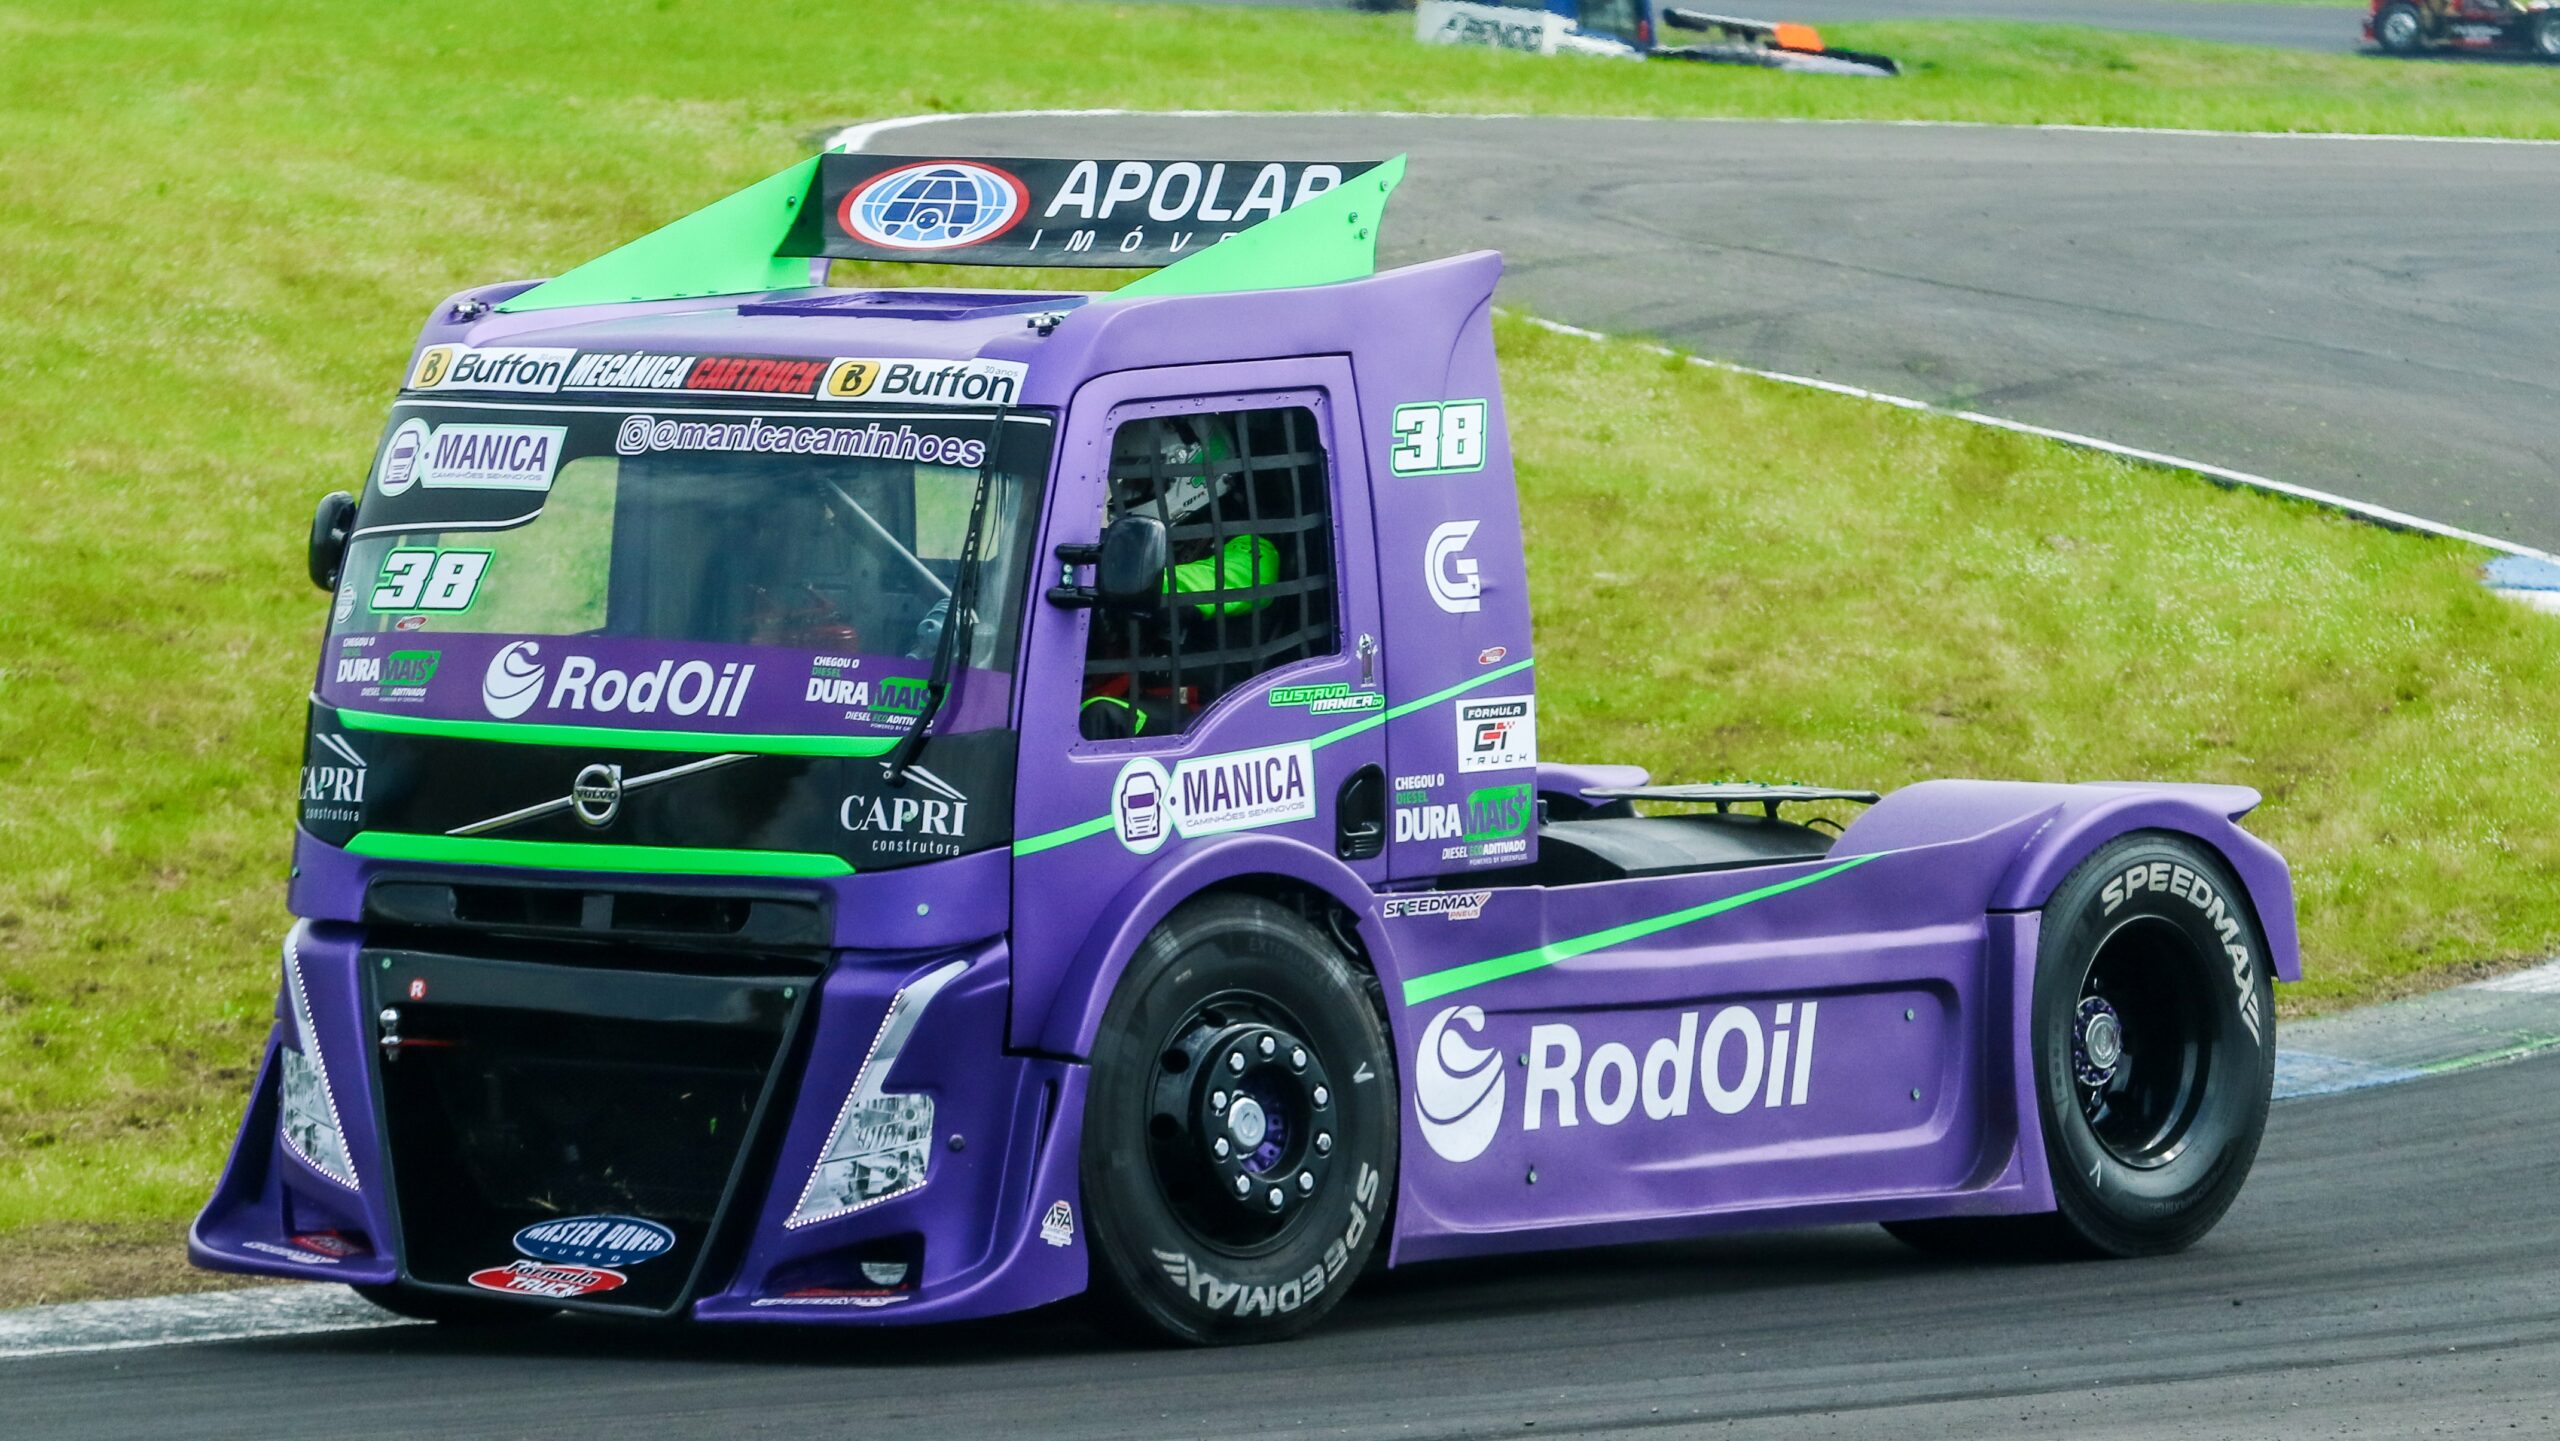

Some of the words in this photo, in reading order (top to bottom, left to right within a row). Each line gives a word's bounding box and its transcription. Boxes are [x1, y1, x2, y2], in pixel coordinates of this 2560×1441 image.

[1028, 226, 1236, 253] IMÓV
[451, 353, 560, 386] Buffon
[562, 350, 697, 389] MECÂNICA
[687, 357, 829, 393] CARTRUCK
[881, 363, 1016, 403] Buffon
[651, 418, 985, 467] @manicacaminhoes
[1391, 400, 1487, 477] 38
[433, 433, 549, 472] MANICA
[369, 547, 494, 613] 38
[336, 657, 381, 683] DURA
[813, 656, 851, 668] CHEGOU
[851, 658, 860, 669] O
[547, 655, 756, 717] RodOil
[805, 677, 868, 706] DURA
[1270, 686, 1348, 703] GUSTAVO
[845, 711, 871, 722] DIESEL
[1311, 695, 1373, 712] MANICA
[1467, 706, 1522, 719] FORMULA
[1466, 753, 1527, 766] TRUCK
[576, 789, 618, 800] VOLVO
[1183, 754, 1305, 816] MANICA
[1395, 774, 1435, 790] CHEGOU
[1436, 773, 1445, 787] O
[840, 795, 968, 836] CAPRI
[1186, 812, 1246, 828] CAMINHÕES
[1247, 801, 1305, 818] SEMINOVOS
[1395, 803, 1462, 842] DURA
[872, 838, 960, 856] construtora
[1442, 845, 1468, 860] DIESEL
[1385, 894, 1480, 915] SPEEDMAX
[1449, 908, 1478, 918] PNEUS
[2103, 862, 2260, 1047] SPEEDMAX
[1523, 1001, 1818, 1131] RodOil
[525, 1221, 611, 1247] MASTER
[596, 1222, 666, 1252] POWER
[1152, 1163, 1379, 1317] SPEEDMAX
[543, 1246, 621, 1262] TURBO
[504, 1260, 600, 1287] Formula
[506, 1275, 584, 1298] TRUCK
